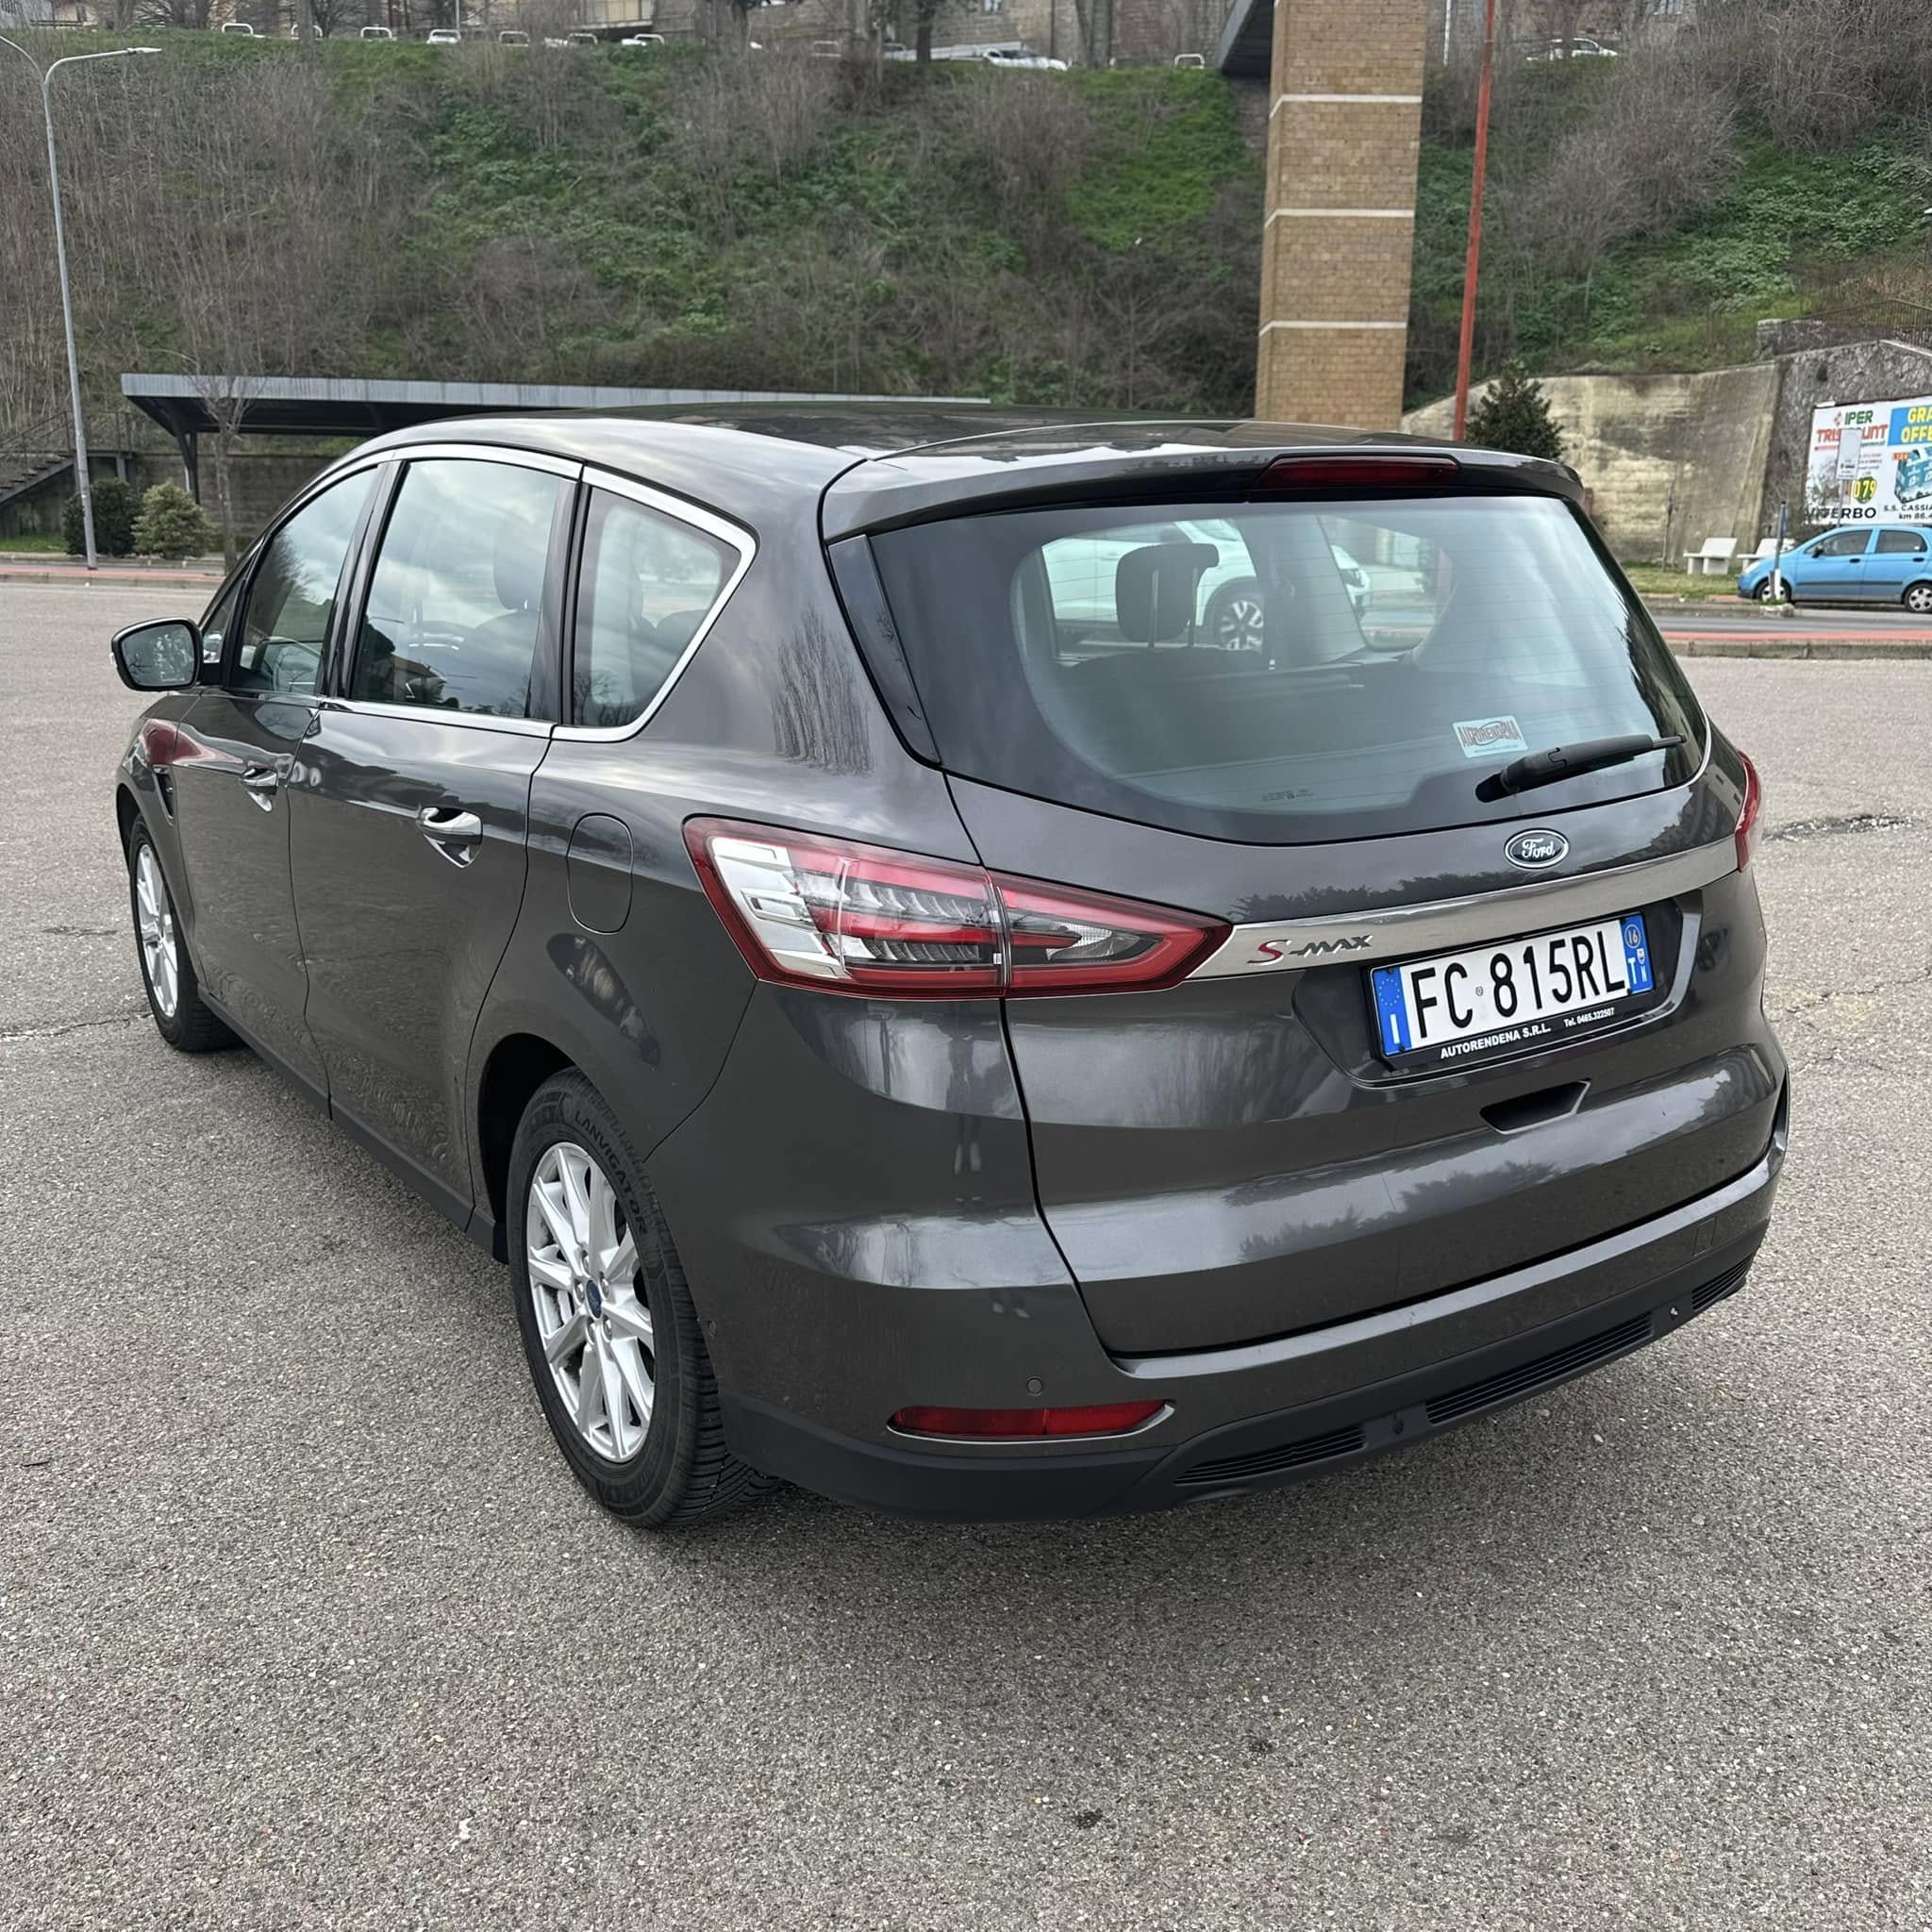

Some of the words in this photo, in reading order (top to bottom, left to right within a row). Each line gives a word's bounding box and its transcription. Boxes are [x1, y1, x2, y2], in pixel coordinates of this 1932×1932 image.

[1844, 409, 1874, 425] IPER
[1522, 838, 1556, 858] Ford
[1247, 935, 1374, 966] S-MAX
[1628, 928, 1639, 944] 16
[1411, 962, 1474, 1039] FC
[1490, 931, 1625, 1018] 815RL
[1390, 1013, 1401, 1043] I
[1441, 1028, 1522, 1059] AUTORENDENA
[1522, 1023, 1552, 1039] S.R.L.
[1563, 1018, 1576, 1027] Tel.
[575, 1110, 648, 1236] LANVIGATOR
